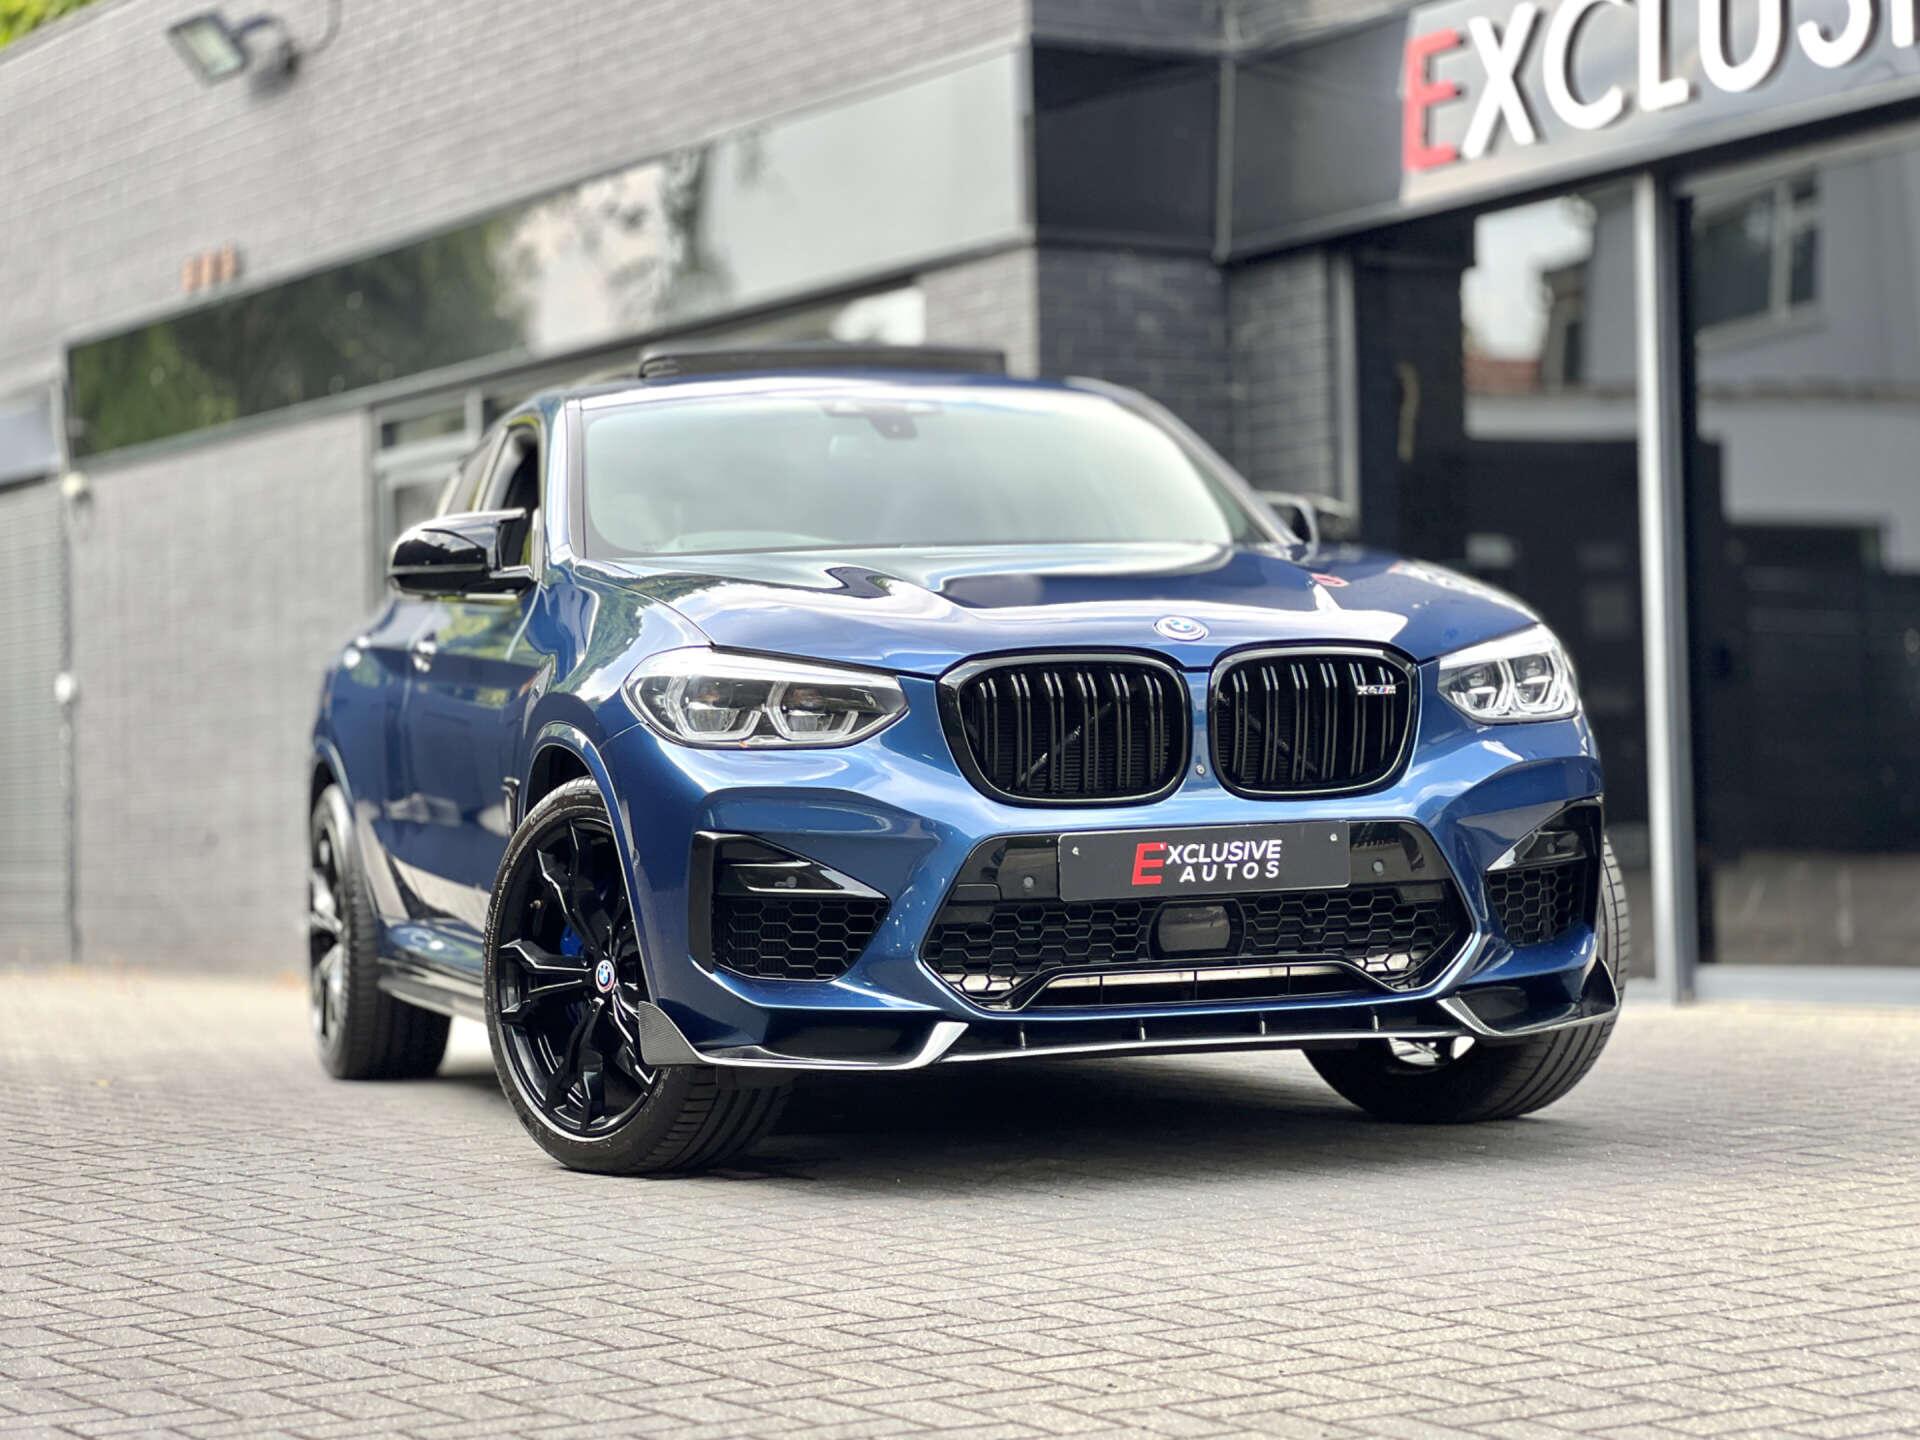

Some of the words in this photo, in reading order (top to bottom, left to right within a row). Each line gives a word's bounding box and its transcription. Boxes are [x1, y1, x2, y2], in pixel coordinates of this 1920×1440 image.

[1404, 0, 1915, 172] EXCLU
[1131, 839, 1283, 886] EXCLUSIVE
[1179, 860, 1280, 883] AUTOS
